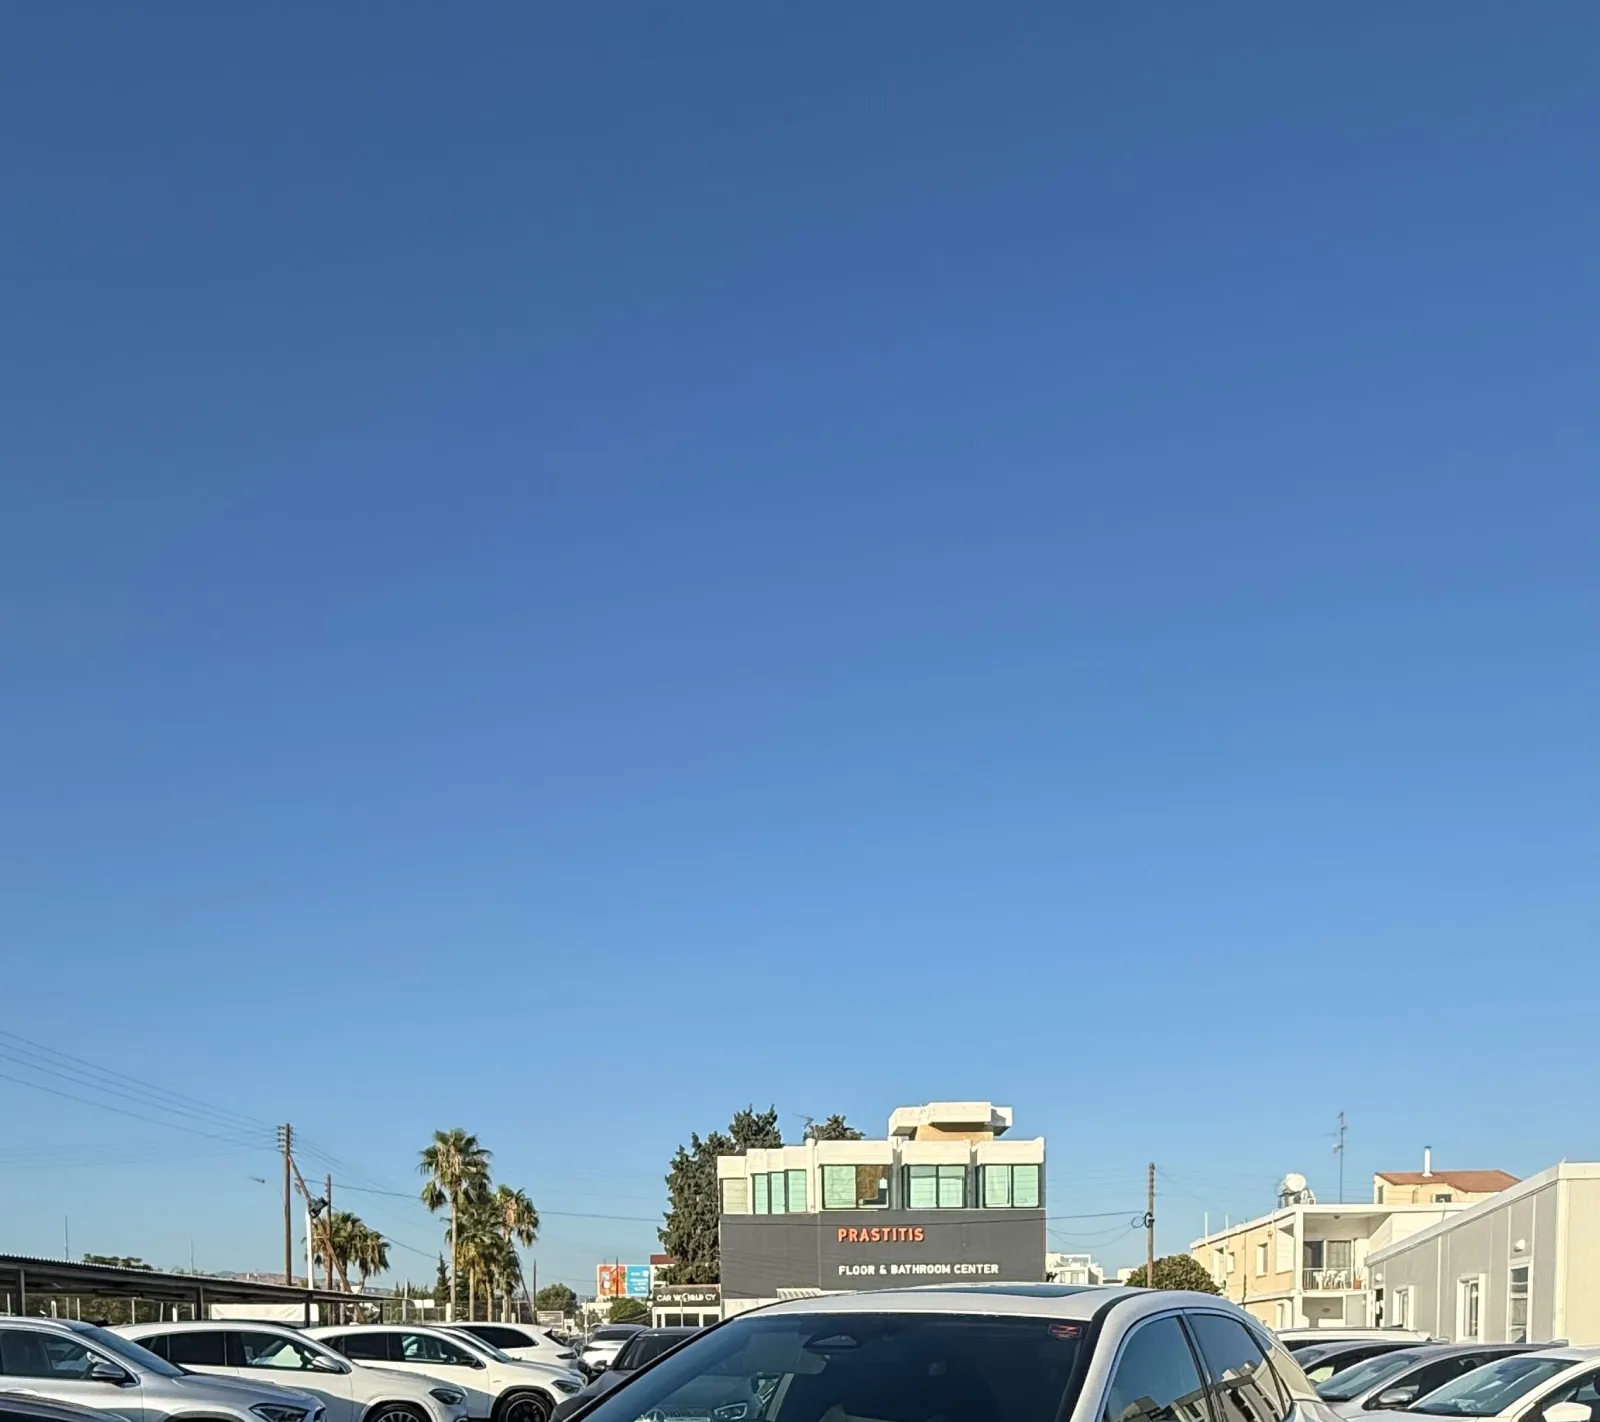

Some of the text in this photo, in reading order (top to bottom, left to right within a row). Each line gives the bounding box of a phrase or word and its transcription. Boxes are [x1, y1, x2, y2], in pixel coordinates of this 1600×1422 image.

[837, 1227, 925, 1242] PRASTITIS
[838, 1263, 999, 1275] FLOOR & BATHROOM CENTER
[656, 1293, 717, 1302] CAR WORLD CY
